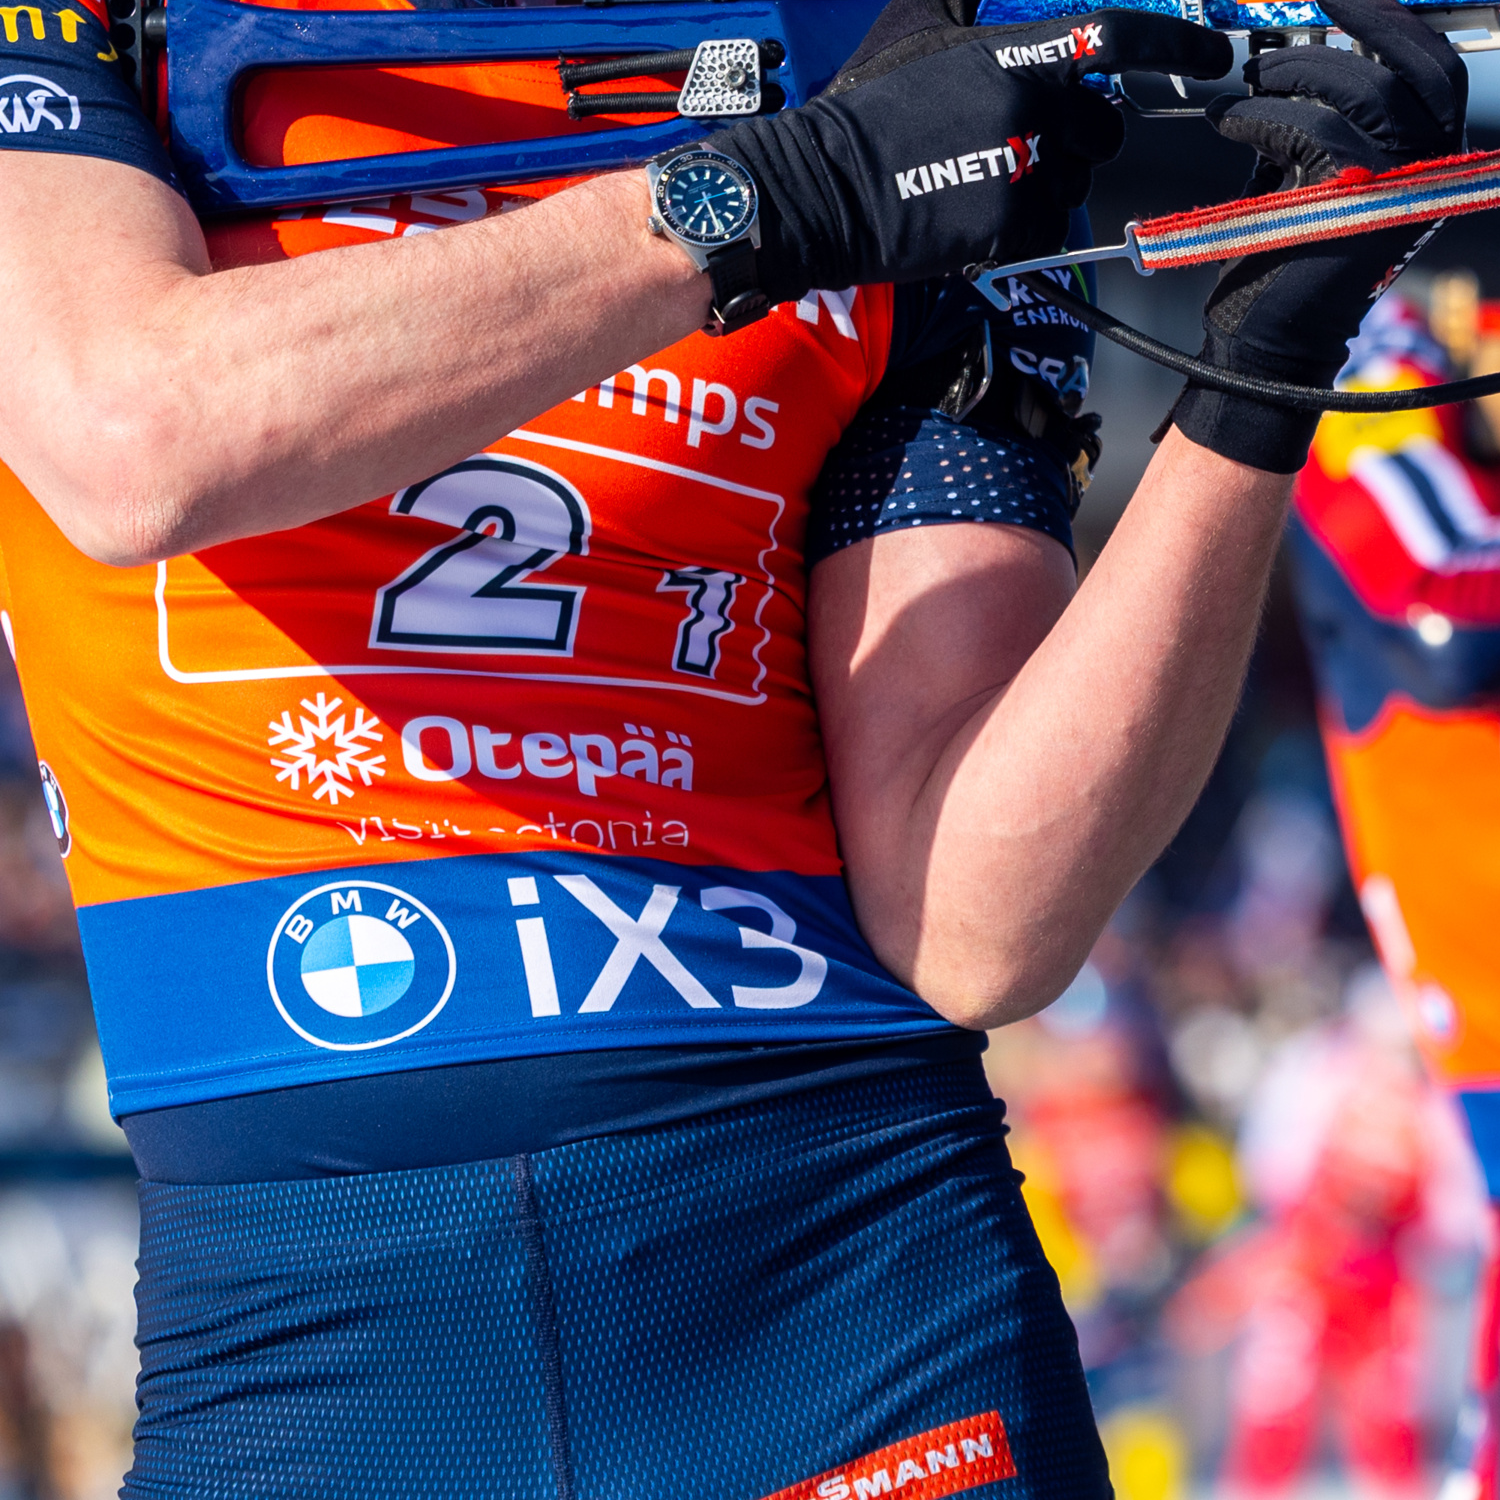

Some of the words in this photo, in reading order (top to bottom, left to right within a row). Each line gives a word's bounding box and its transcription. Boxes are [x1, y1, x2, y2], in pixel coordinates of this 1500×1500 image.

[571, 364, 780, 450] mps
[367, 452, 592, 657] 2
[655, 566, 746, 680] 1
[401, 715, 694, 797] Otepää
[284, 889, 421, 946] BMW
[507, 874, 829, 1018] iX3
